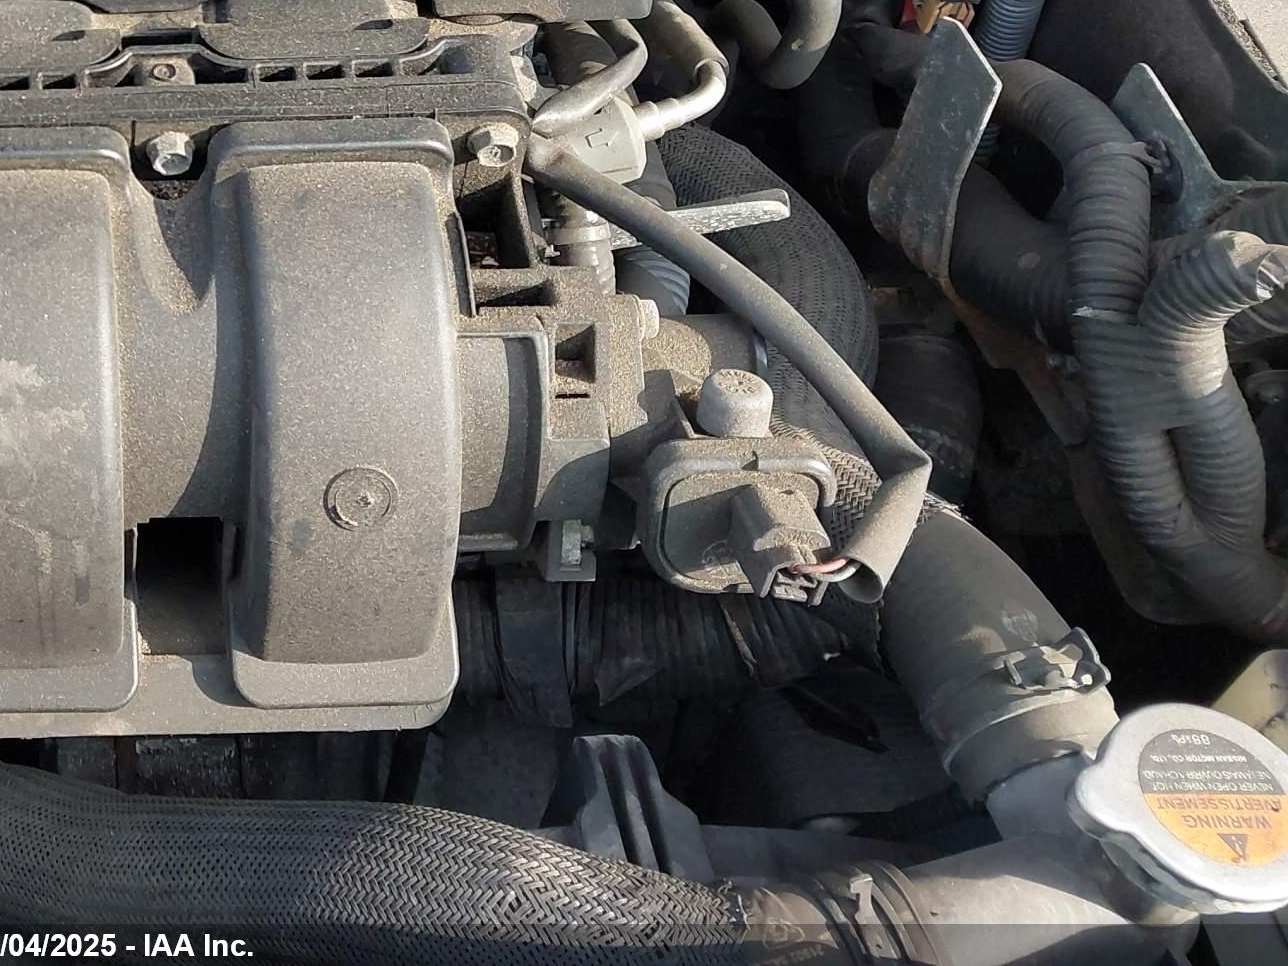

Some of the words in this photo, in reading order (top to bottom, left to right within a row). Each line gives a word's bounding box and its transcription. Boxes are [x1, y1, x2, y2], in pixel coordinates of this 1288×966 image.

[1186, 754, 1215, 763] MOTOR
[1215, 754, 1248, 763] NISSAN
[1175, 782, 1208, 792] WHEN
[1208, 782, 1238, 792] OPEN
[1240, 782, 1274, 792] NEVER
[1156, 797, 1281, 811] AVERTISSEMENT
[1184, 814, 1272, 829] WARNING
